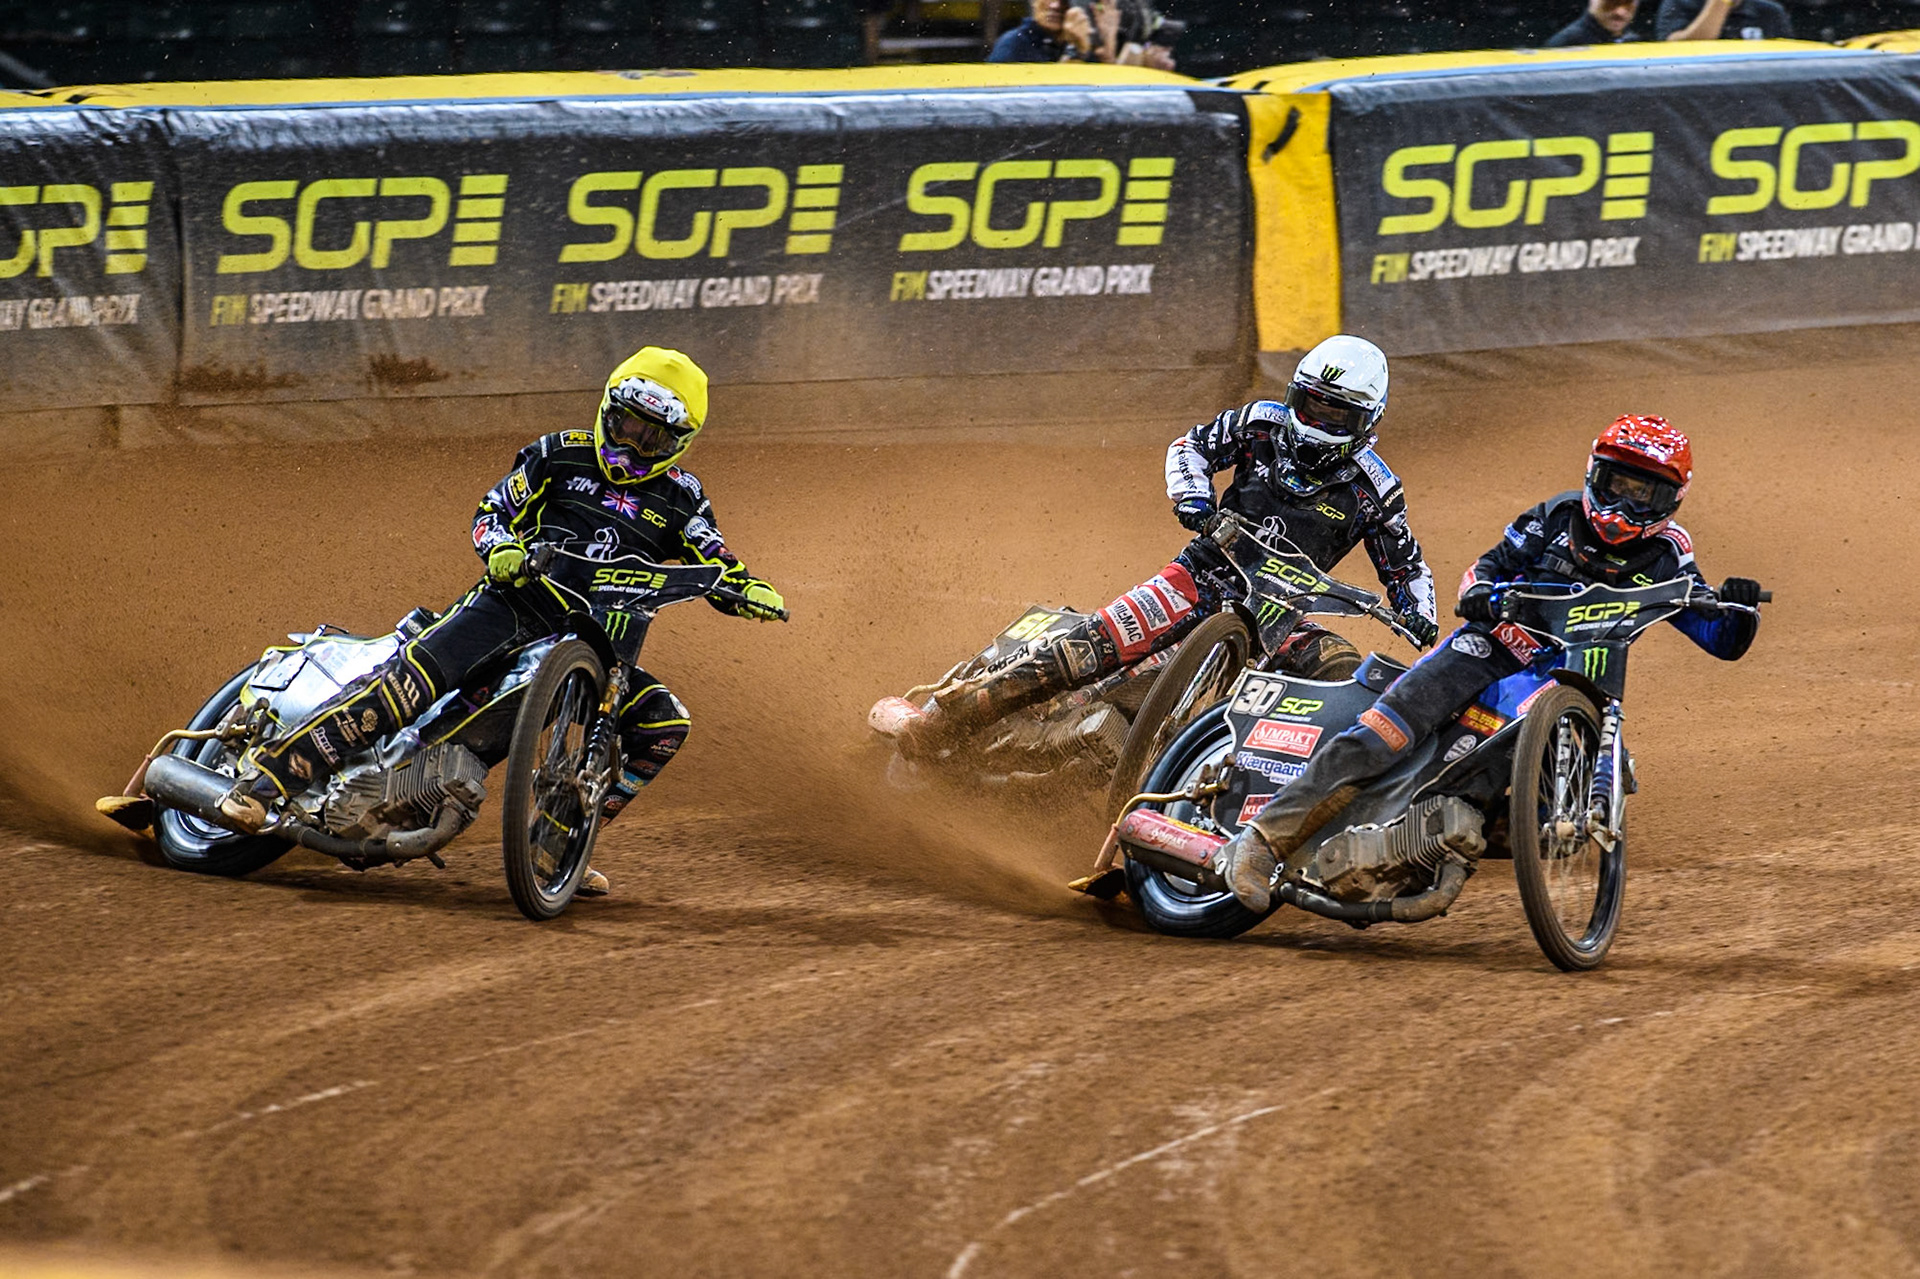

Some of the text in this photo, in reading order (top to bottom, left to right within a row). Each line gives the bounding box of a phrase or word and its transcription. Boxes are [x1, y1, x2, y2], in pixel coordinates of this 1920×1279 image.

[1377, 136, 1601, 235] SGP
[1706, 120, 1920, 215] SGP
[558, 167, 787, 262] SGP
[900, 159, 1120, 252] SGP
[217, 176, 450, 274] SGP
[1736, 226, 1843, 261] SPEEDWAY
[1841, 221, 1914, 255] GRAND
[1409, 244, 1518, 280] SPEEDWAY
[1518, 240, 1588, 273] GRAND
[1587, 236, 1641, 268] PRIX
[588, 278, 700, 312] SPEEDWAY
[701, 275, 772, 308] GRAND
[773, 273, 824, 304] PRIX
[926, 268, 1035, 300] SPEEDWAY
[1033, 265, 1105, 297] GRAND
[1105, 263, 1154, 295] PRIX
[249, 289, 362, 324] SPEEDWAY
[362, 287, 436, 320] GRAND
[437, 285, 489, 317] PRIX
[565, 475, 601, 496] FIM
[592, 568, 652, 586] SGP
[1261, 557, 1317, 586] SGP
[1566, 602, 1625, 625] SGP
[1234, 679, 1285, 715] 30
[1276, 697, 1323, 715] SGP
[1265, 727, 1315, 745] IMPAKT
[1237, 752, 1308, 778] Kjærgaard
